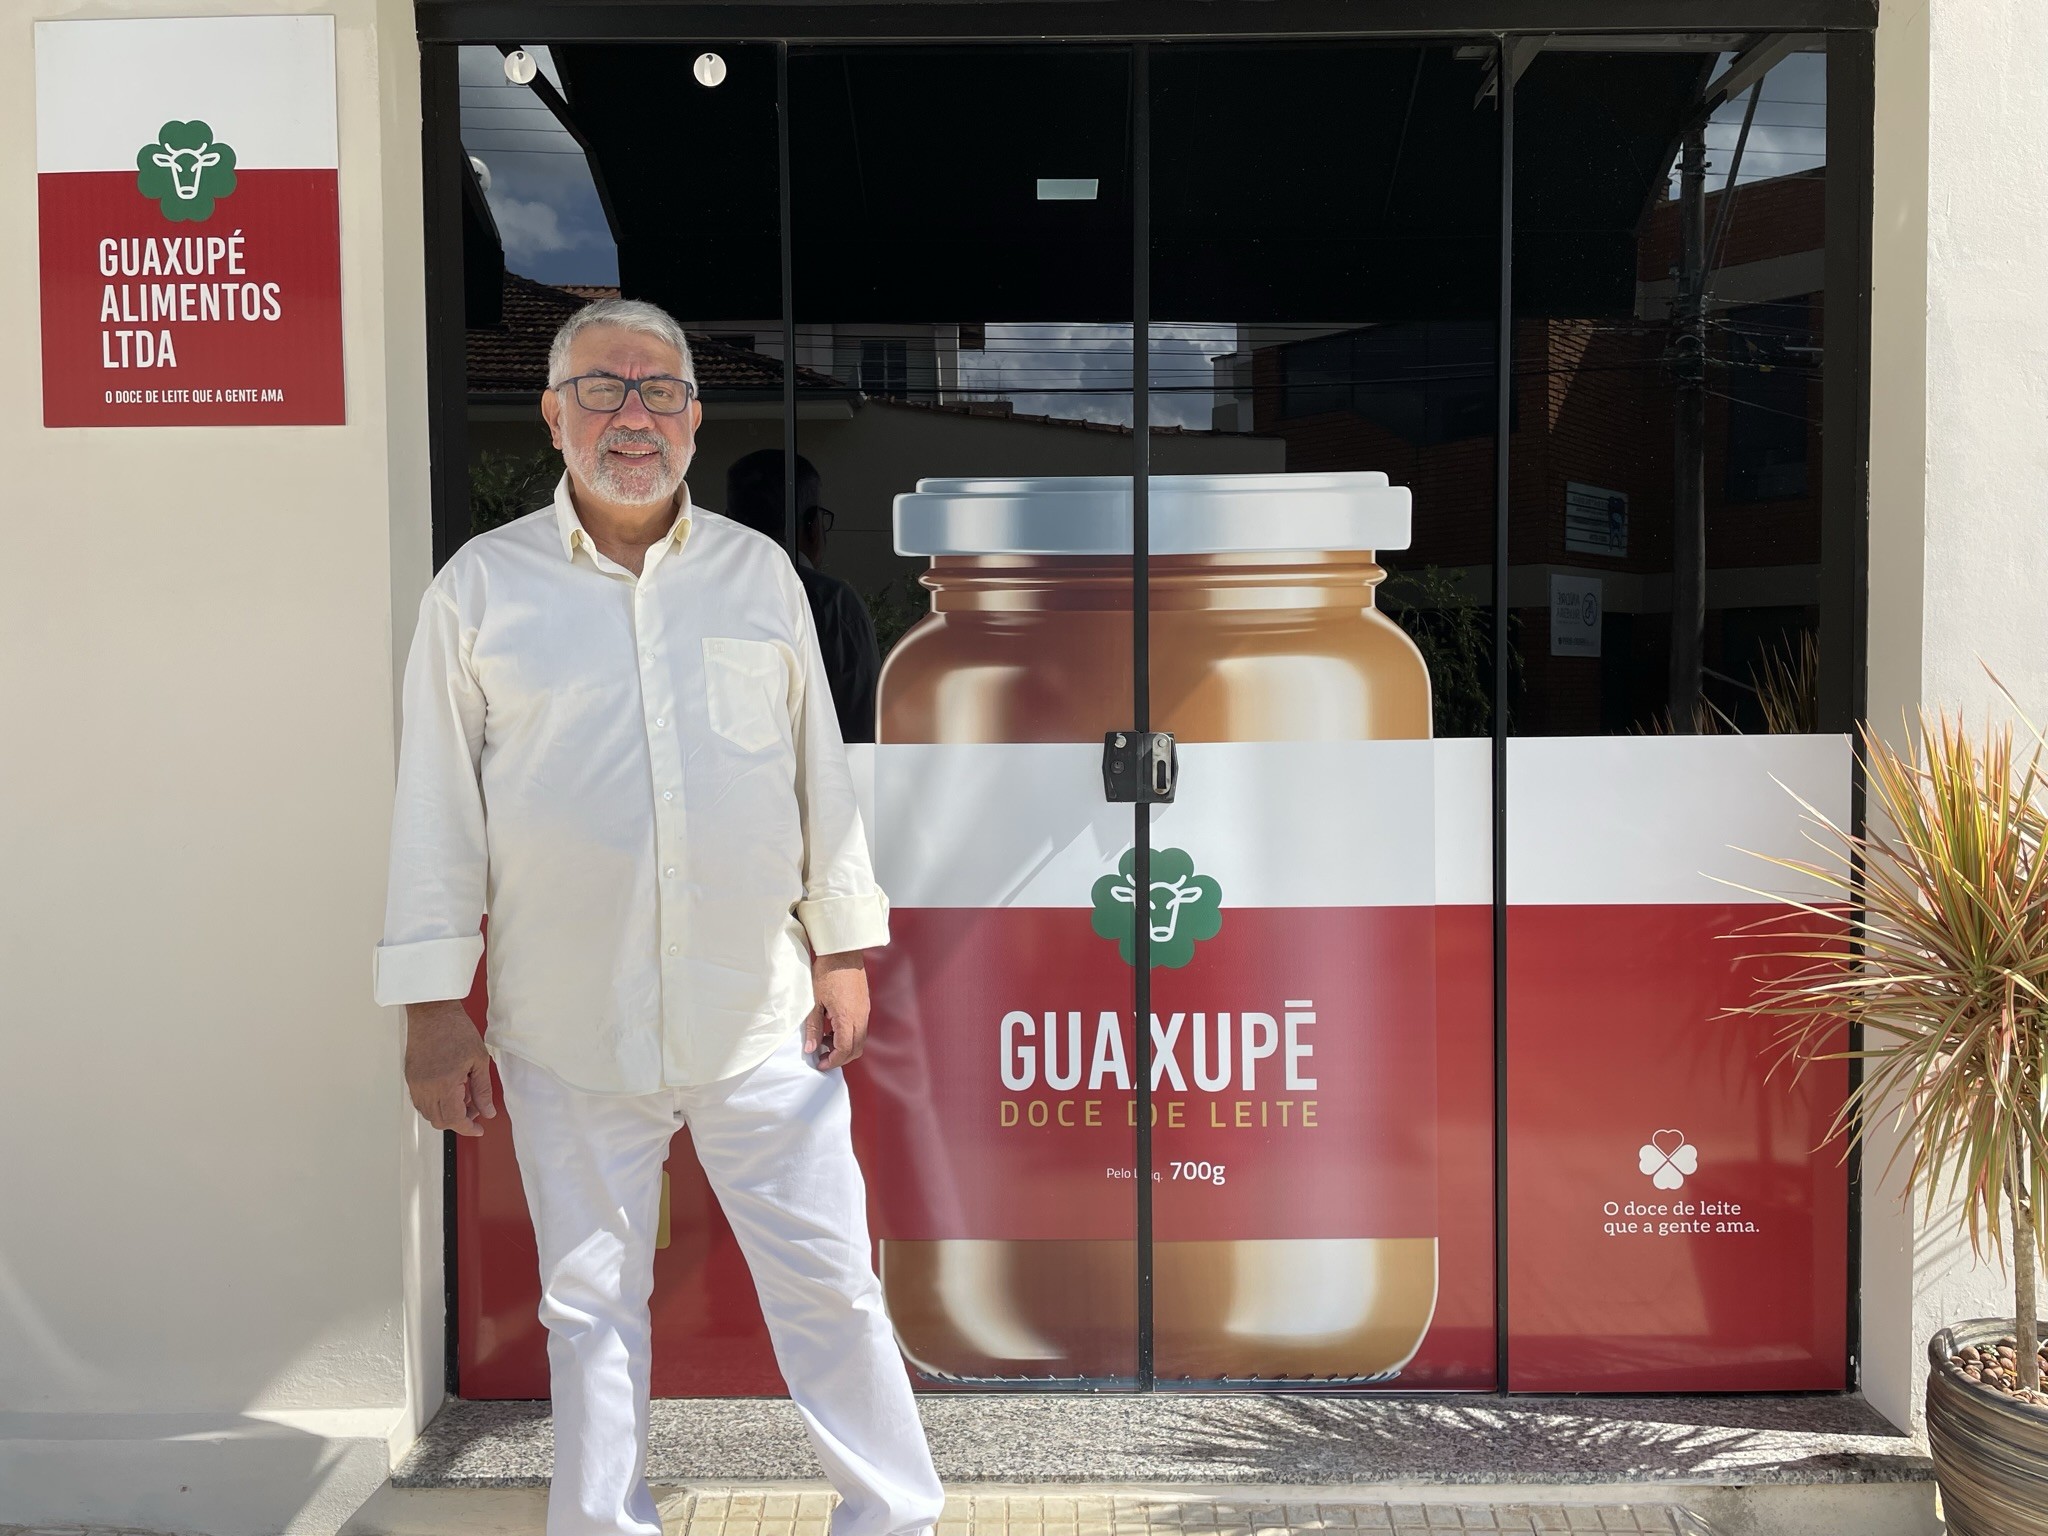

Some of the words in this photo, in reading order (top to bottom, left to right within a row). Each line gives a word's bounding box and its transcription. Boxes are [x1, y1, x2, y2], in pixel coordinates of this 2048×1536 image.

[100, 230, 245, 276] GUAXUPÉ
[100, 283, 281, 322] ALIMENTOS
[102, 330, 177, 369] LTDA
[105, 390, 112, 403] O
[115, 390, 142, 403] DOCE
[145, 390, 159, 403] DE
[161, 390, 190, 403] LEITE
[192, 389, 213, 403] QUE
[215, 389, 223, 402] A
[225, 389, 258, 402] GENTE
[260, 389, 284, 402] AMA
[1001, 1100, 1103, 1127] DOCE
[1127, 1100, 1186, 1128] DE
[1211, 1100, 1318, 1128] LEITE
[1170, 1161, 1226, 1186] 700g
[1603, 1201, 1619, 1216] O
[1624, 1201, 1668, 1216] doce
[1672, 1201, 1695, 1216] de
[1700, 1201, 1741, 1216] leite
[1603, 1222, 1638, 1236] que
[1643, 1222, 1654, 1233] a
[1658, 1220, 1711, 1236] gente
[1715, 1221, 1760, 1233] ama.
